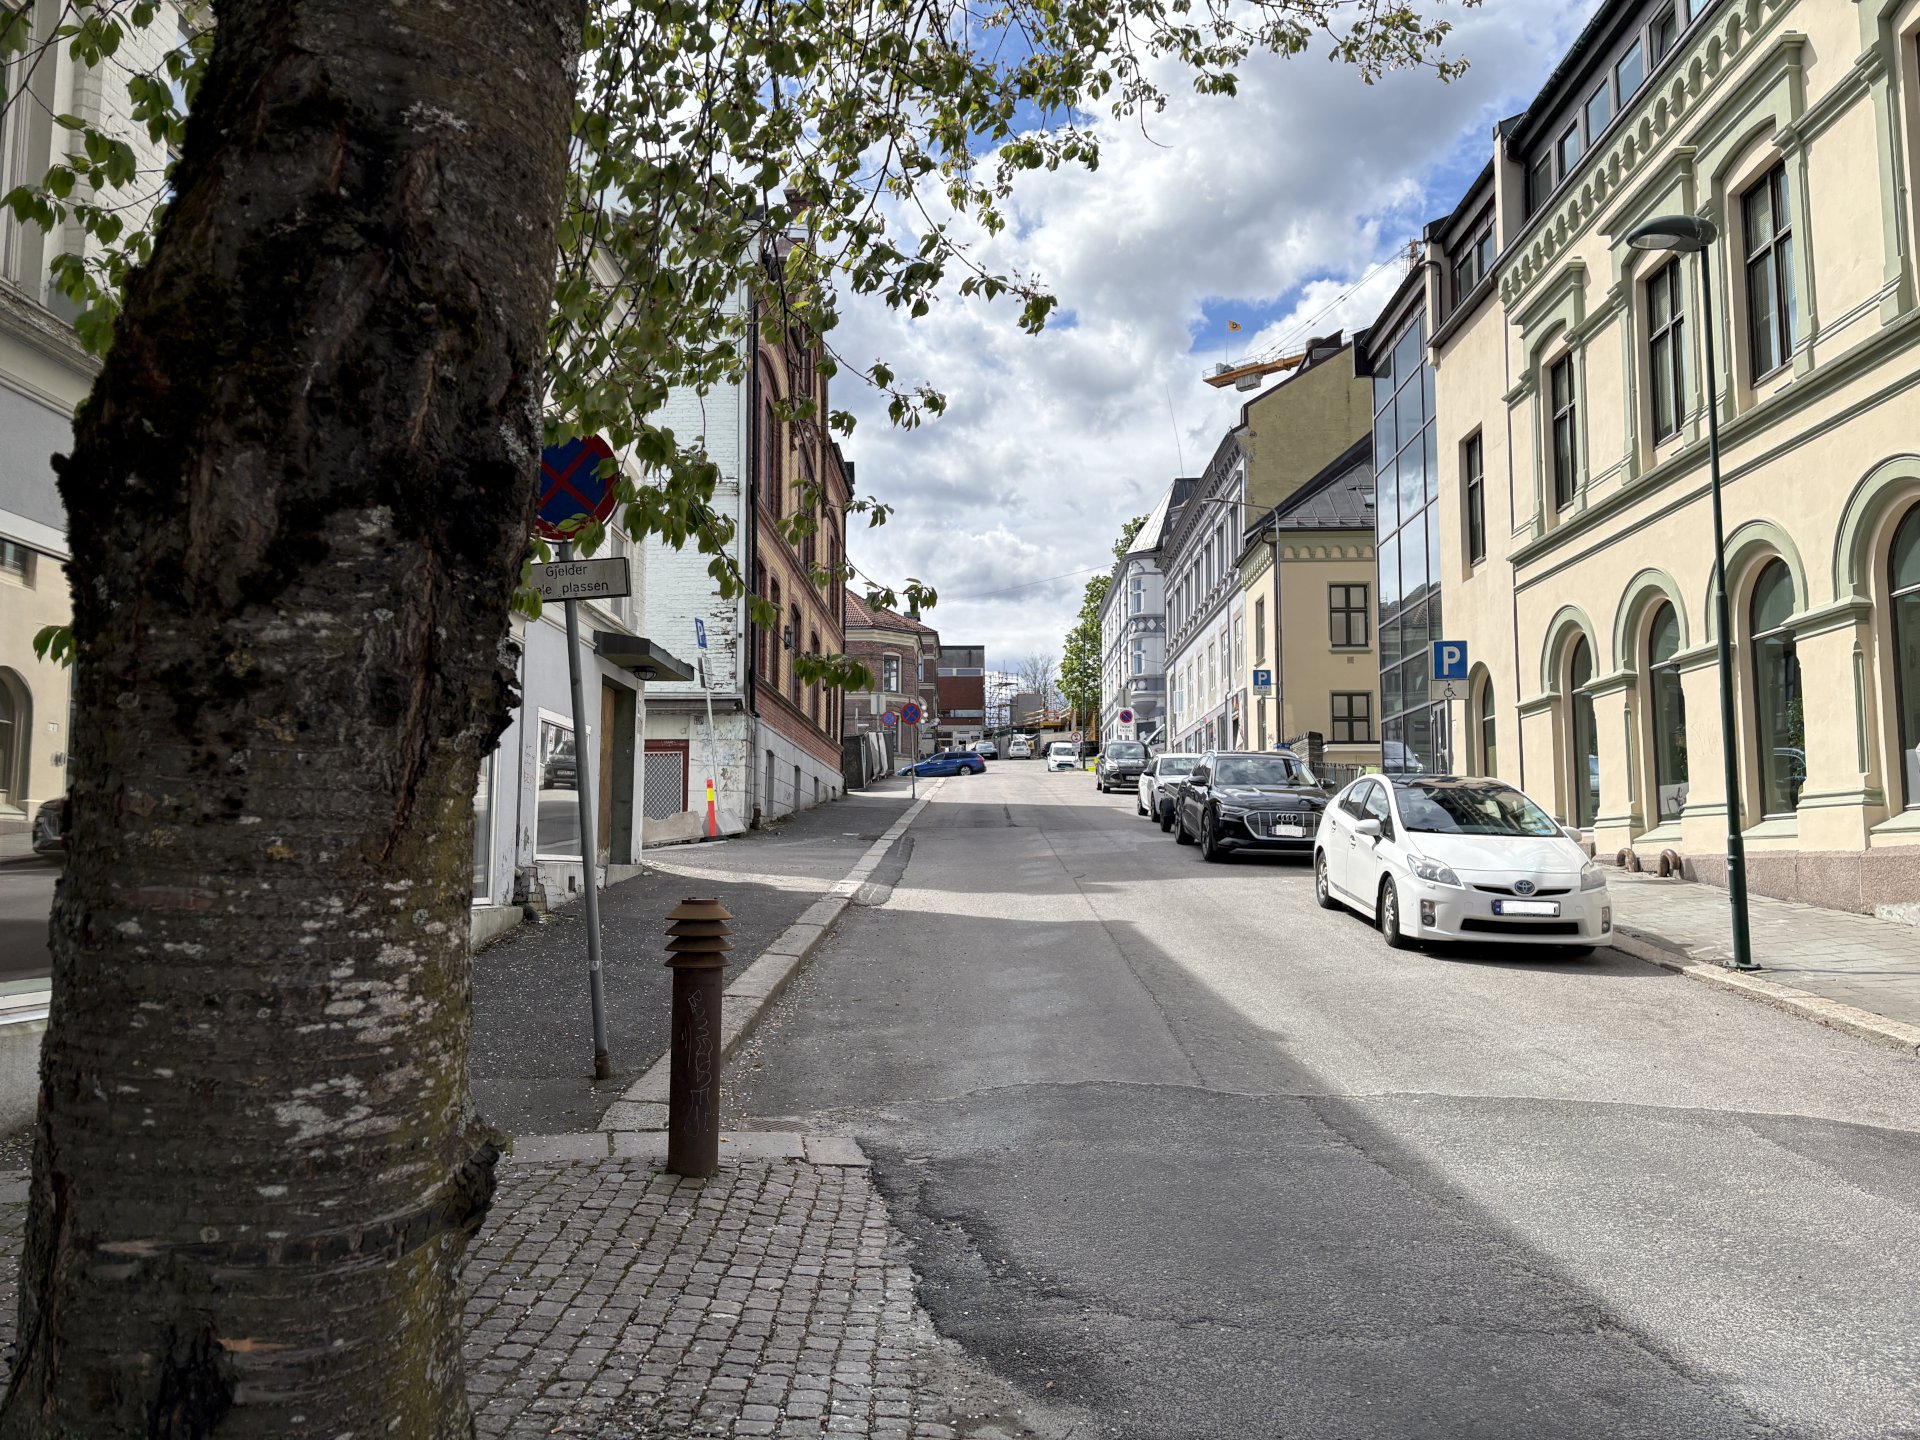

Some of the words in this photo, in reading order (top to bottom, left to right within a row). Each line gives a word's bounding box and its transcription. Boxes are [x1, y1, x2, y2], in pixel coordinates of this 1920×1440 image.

[545, 564, 588, 579] Gjelder
[562, 581, 609, 596] plassen
[696, 621, 704, 644] P
[1443, 646, 1460, 675] P
[1258, 671, 1267, 685] P
